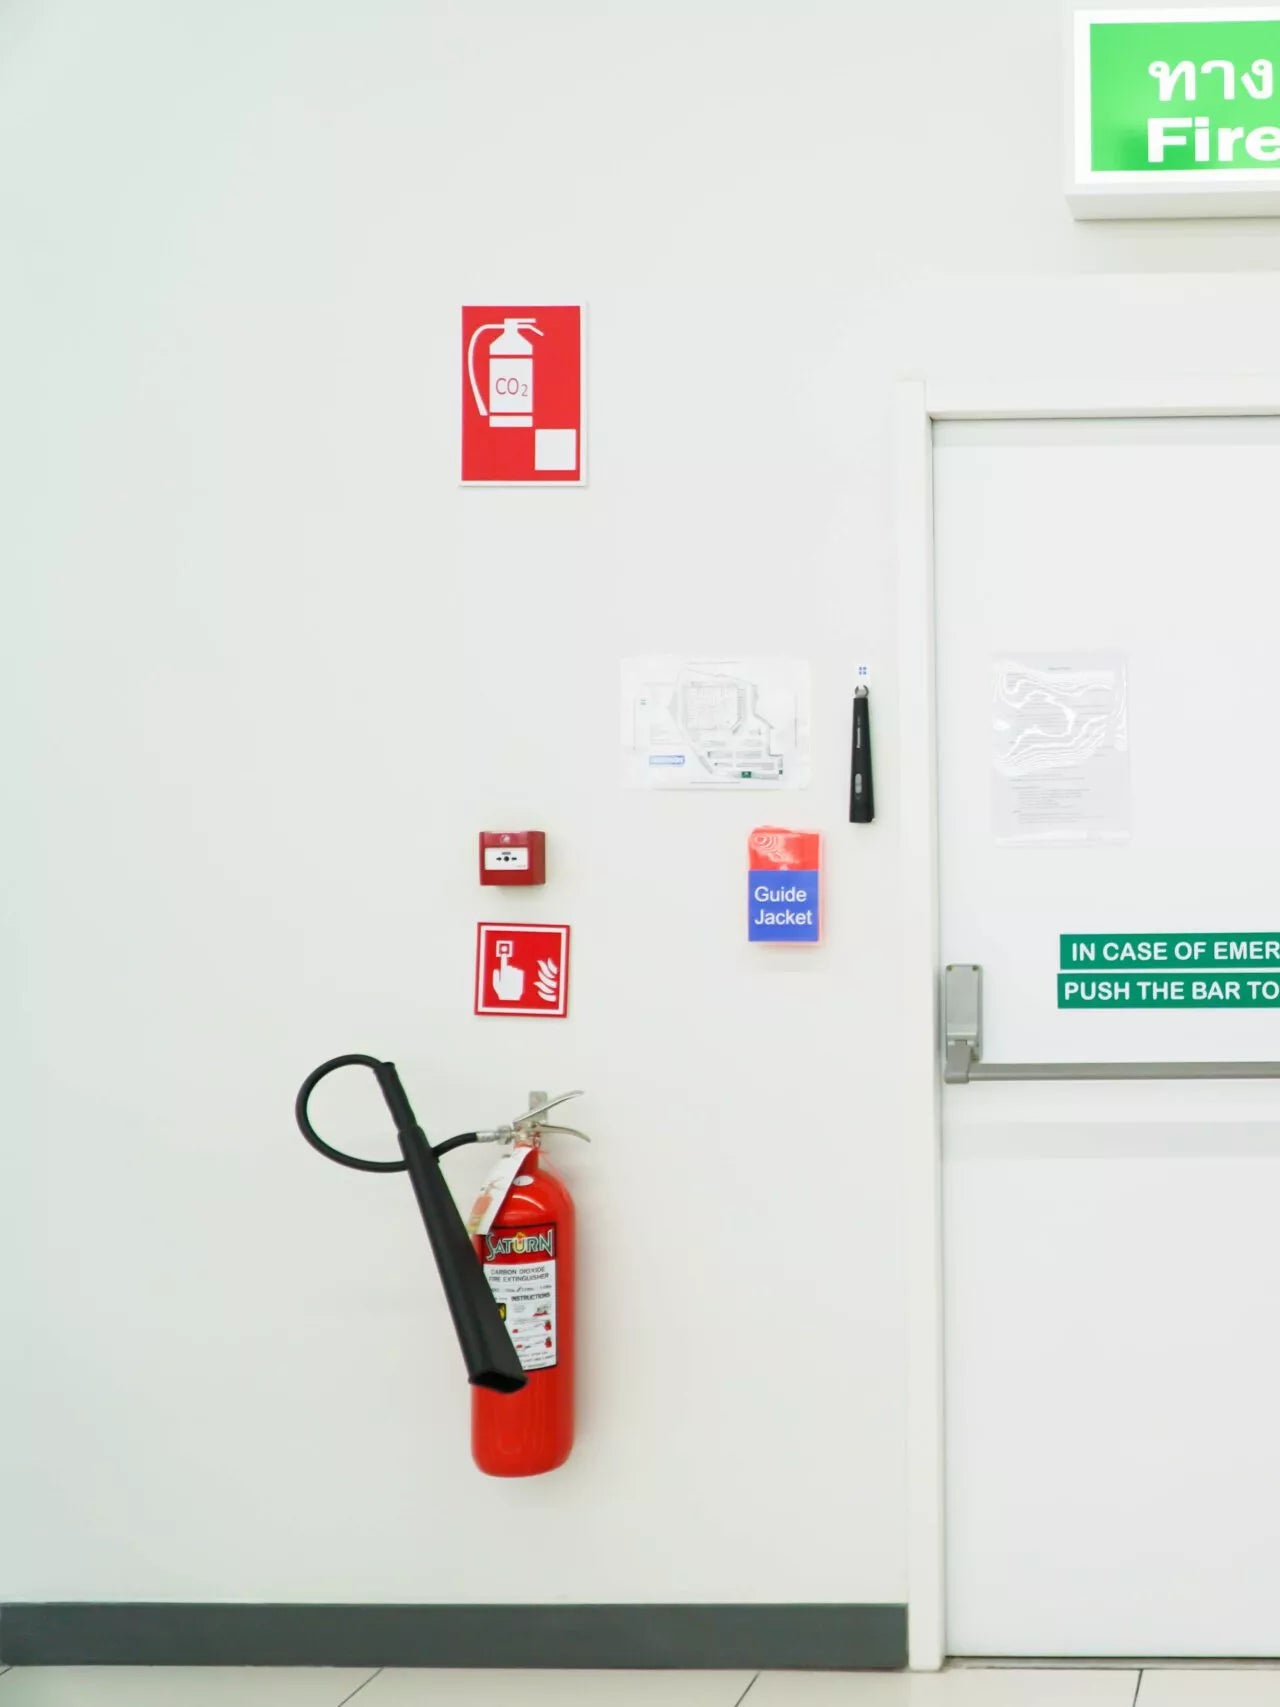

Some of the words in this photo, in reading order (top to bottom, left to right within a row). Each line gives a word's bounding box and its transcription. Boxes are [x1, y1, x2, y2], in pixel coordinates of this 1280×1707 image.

[754, 885, 808, 903] Guide
[754, 909, 813, 926] Jacket
[1072, 942, 1096, 962] IN
[1102, 941, 1168, 961] CASE
[1174, 941, 1207, 961] OF
[1064, 981, 1130, 1001] PUSH
[1136, 981, 1185, 1000] THE
[1191, 981, 1241, 1000] BAR
[1246, 980, 1280, 1000] TO
[486, 1229, 553, 1261] SATURN
